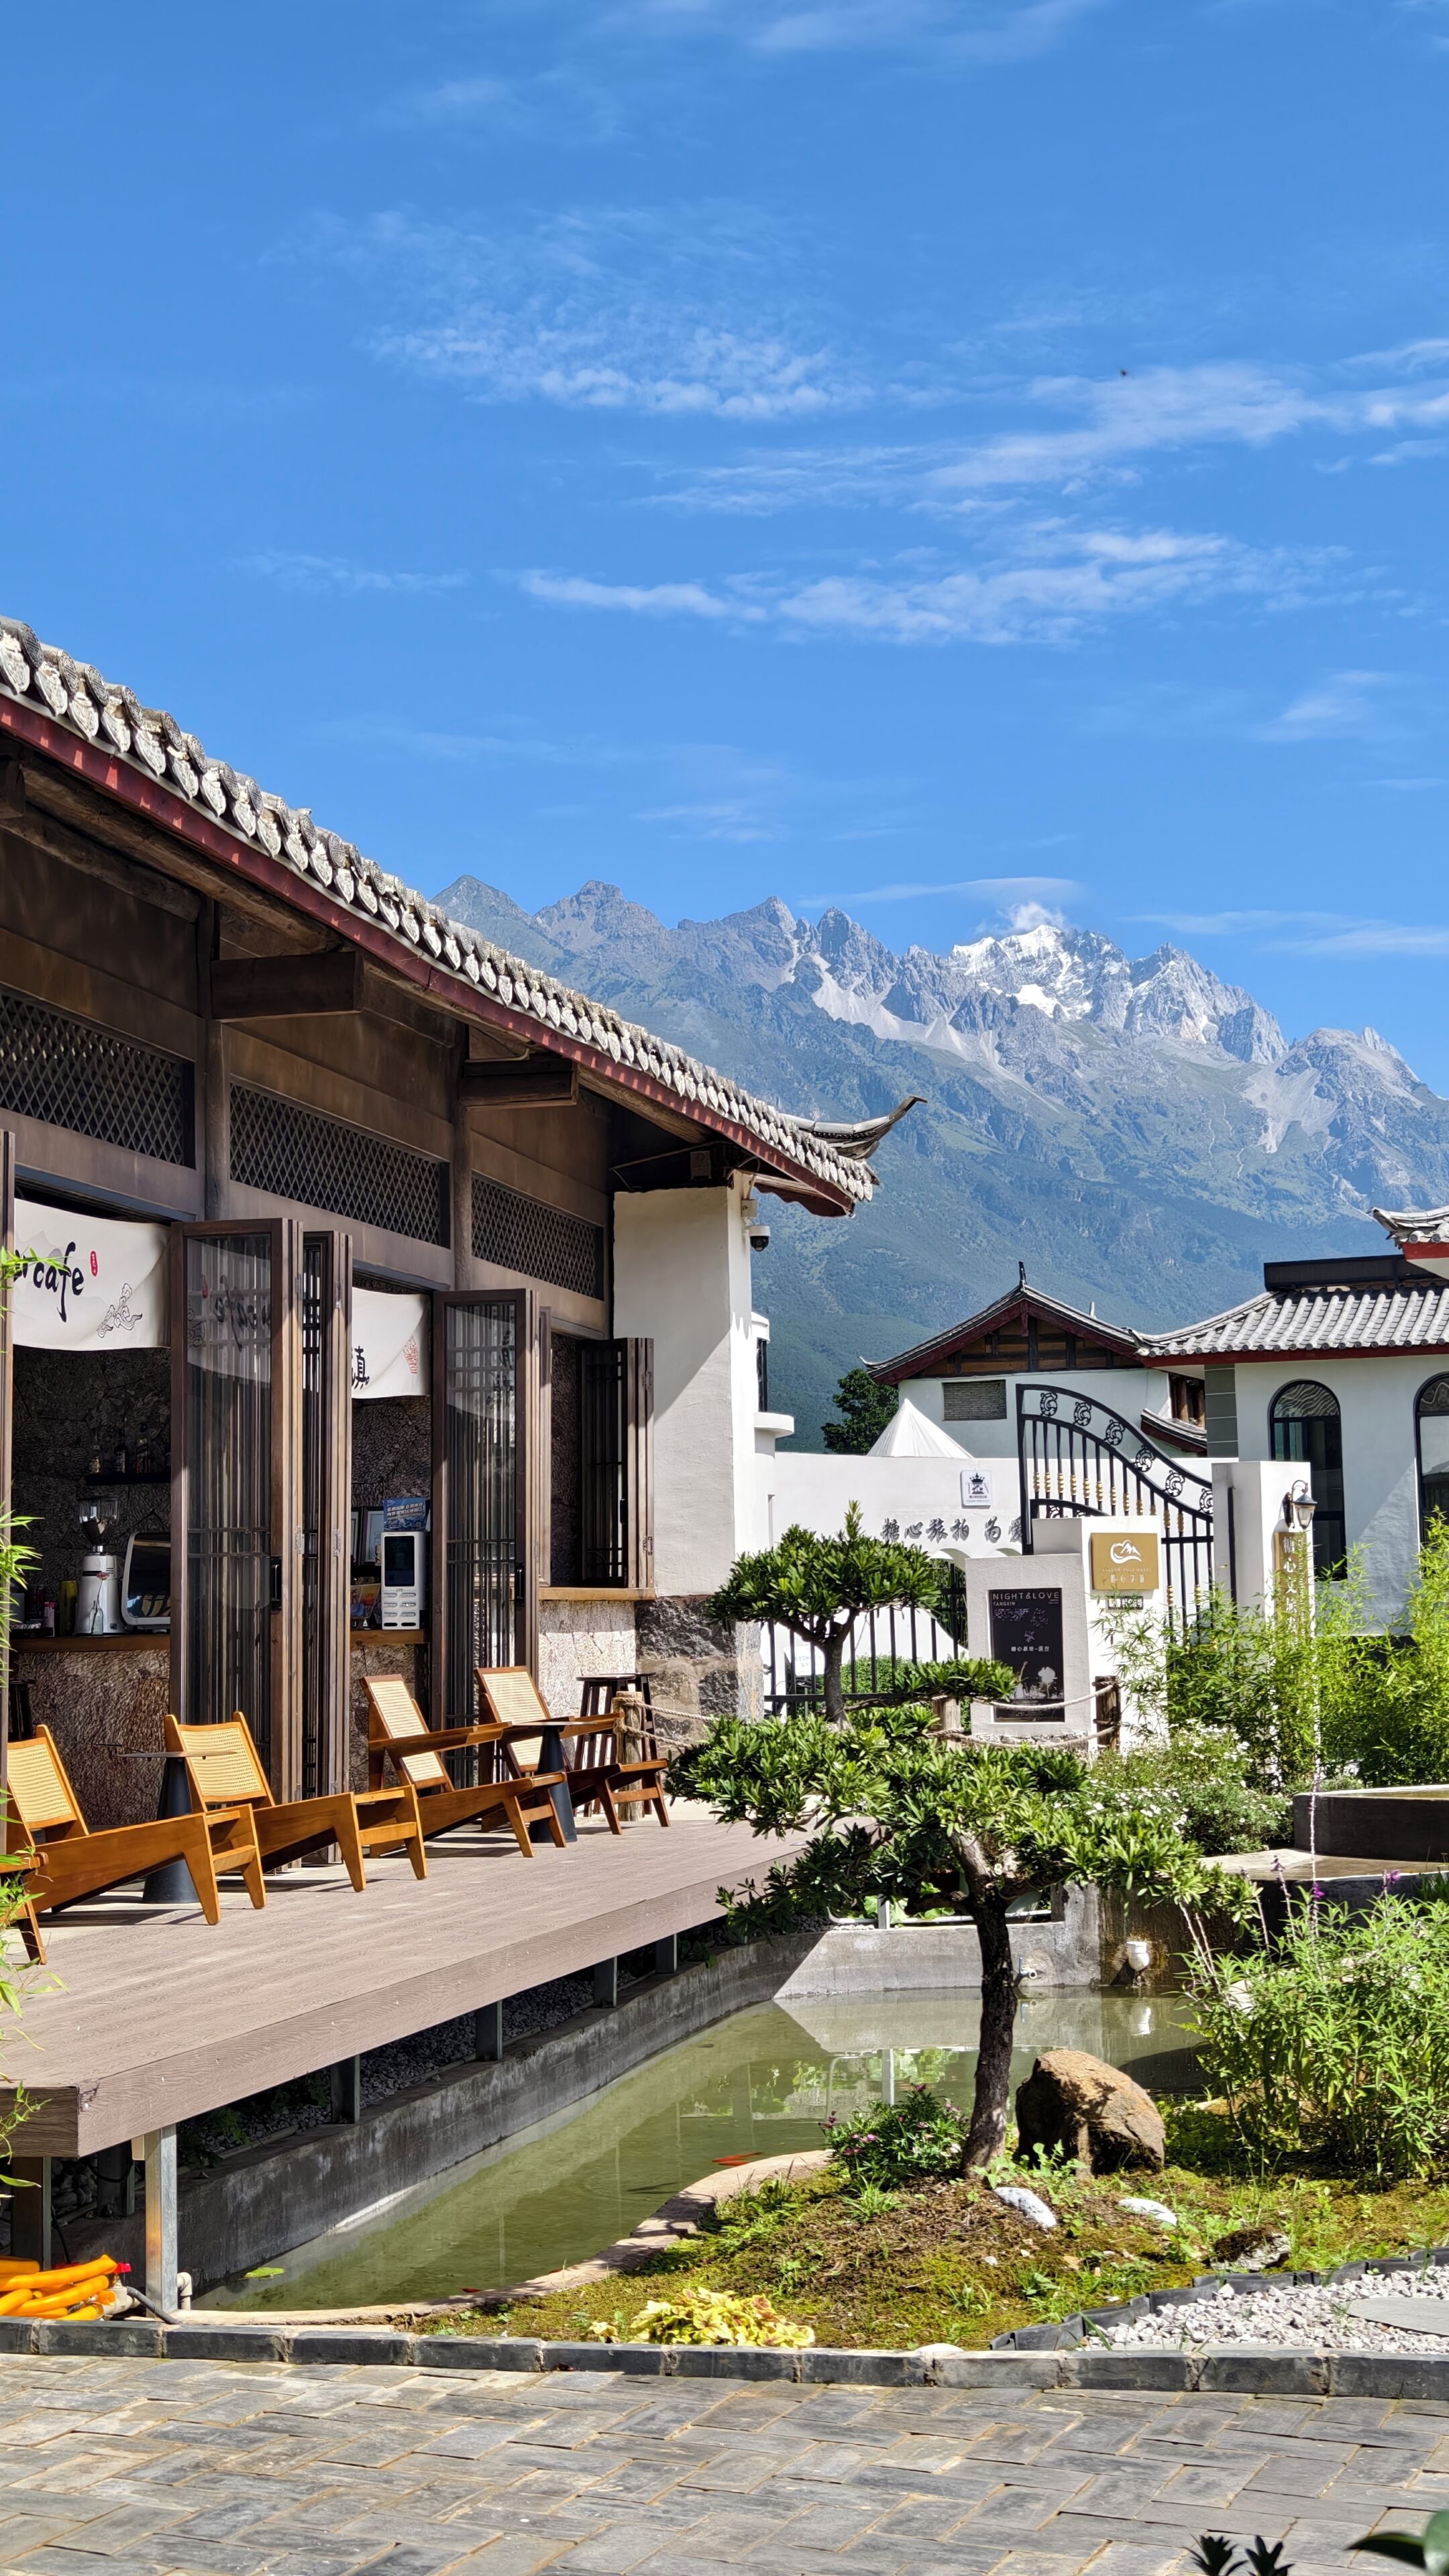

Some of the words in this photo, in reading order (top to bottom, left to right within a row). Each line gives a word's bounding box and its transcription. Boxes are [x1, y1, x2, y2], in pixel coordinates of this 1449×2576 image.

[33, 1242, 85, 1323] cafe
[881, 1517, 969, 1543] 糖心旅拍
[993, 1592, 1059, 1600] NIGHT&LOVE
